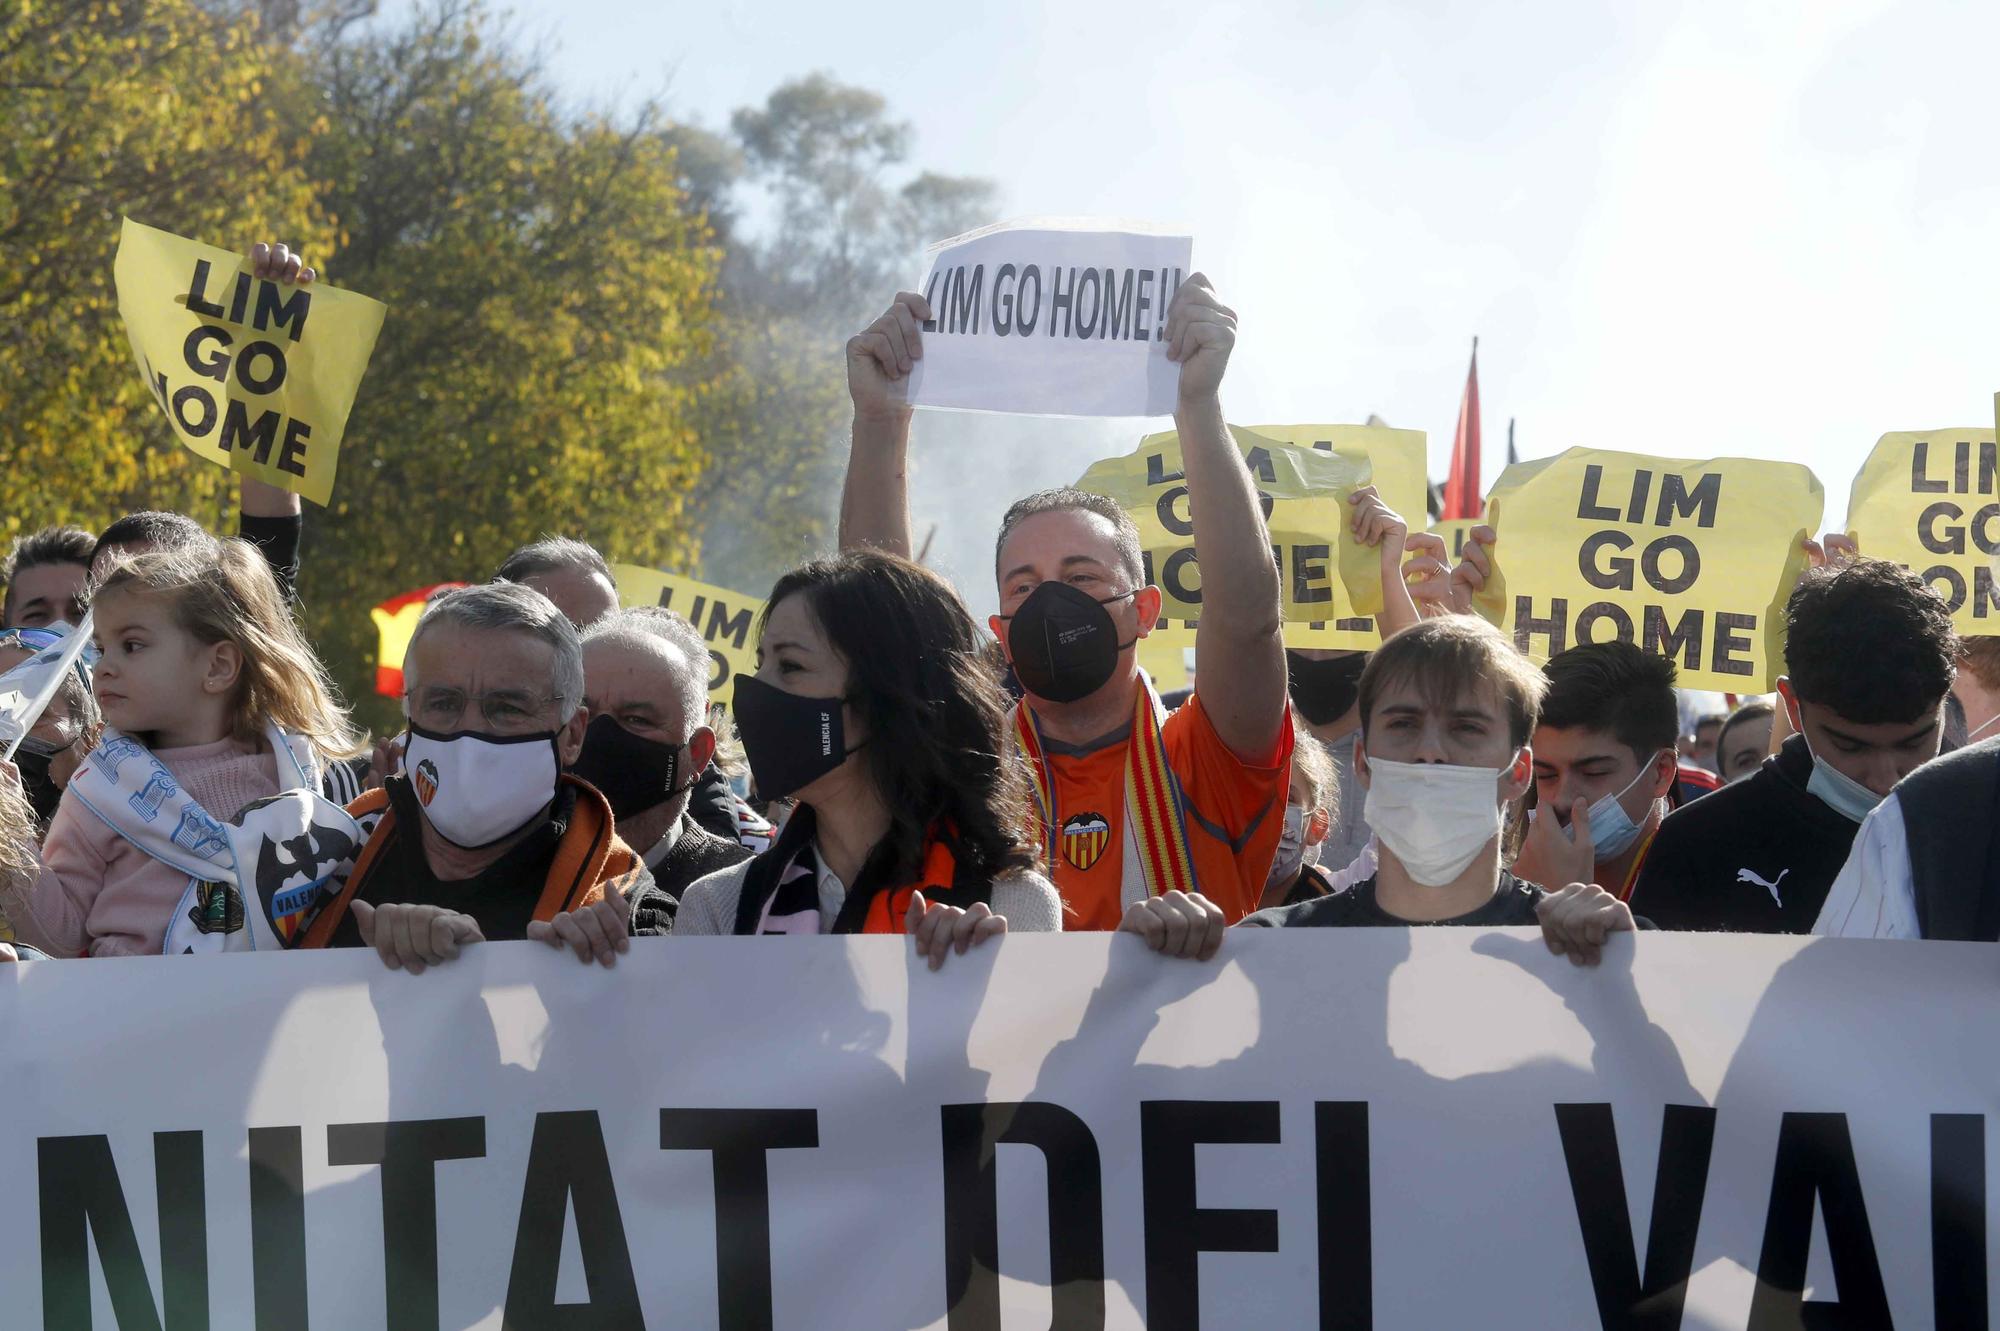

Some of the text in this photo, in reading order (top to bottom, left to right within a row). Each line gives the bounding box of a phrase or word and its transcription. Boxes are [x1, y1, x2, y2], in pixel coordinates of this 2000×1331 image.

[185, 259, 311, 342] LIM
[923, 264, 984, 335] LIM
[992, 263, 1041, 337] GO
[183, 325, 287, 395] GO
[1577, 465, 1721, 528] LIM
[1578, 530, 1701, 595] GO
[1513, 595, 1757, 676] HOME
[821, 712, 832, 756] VALENCIA CF
[664, 754, 673, 792] VALENCIA CF
[37, 1107, 819, 1331] NITAT
